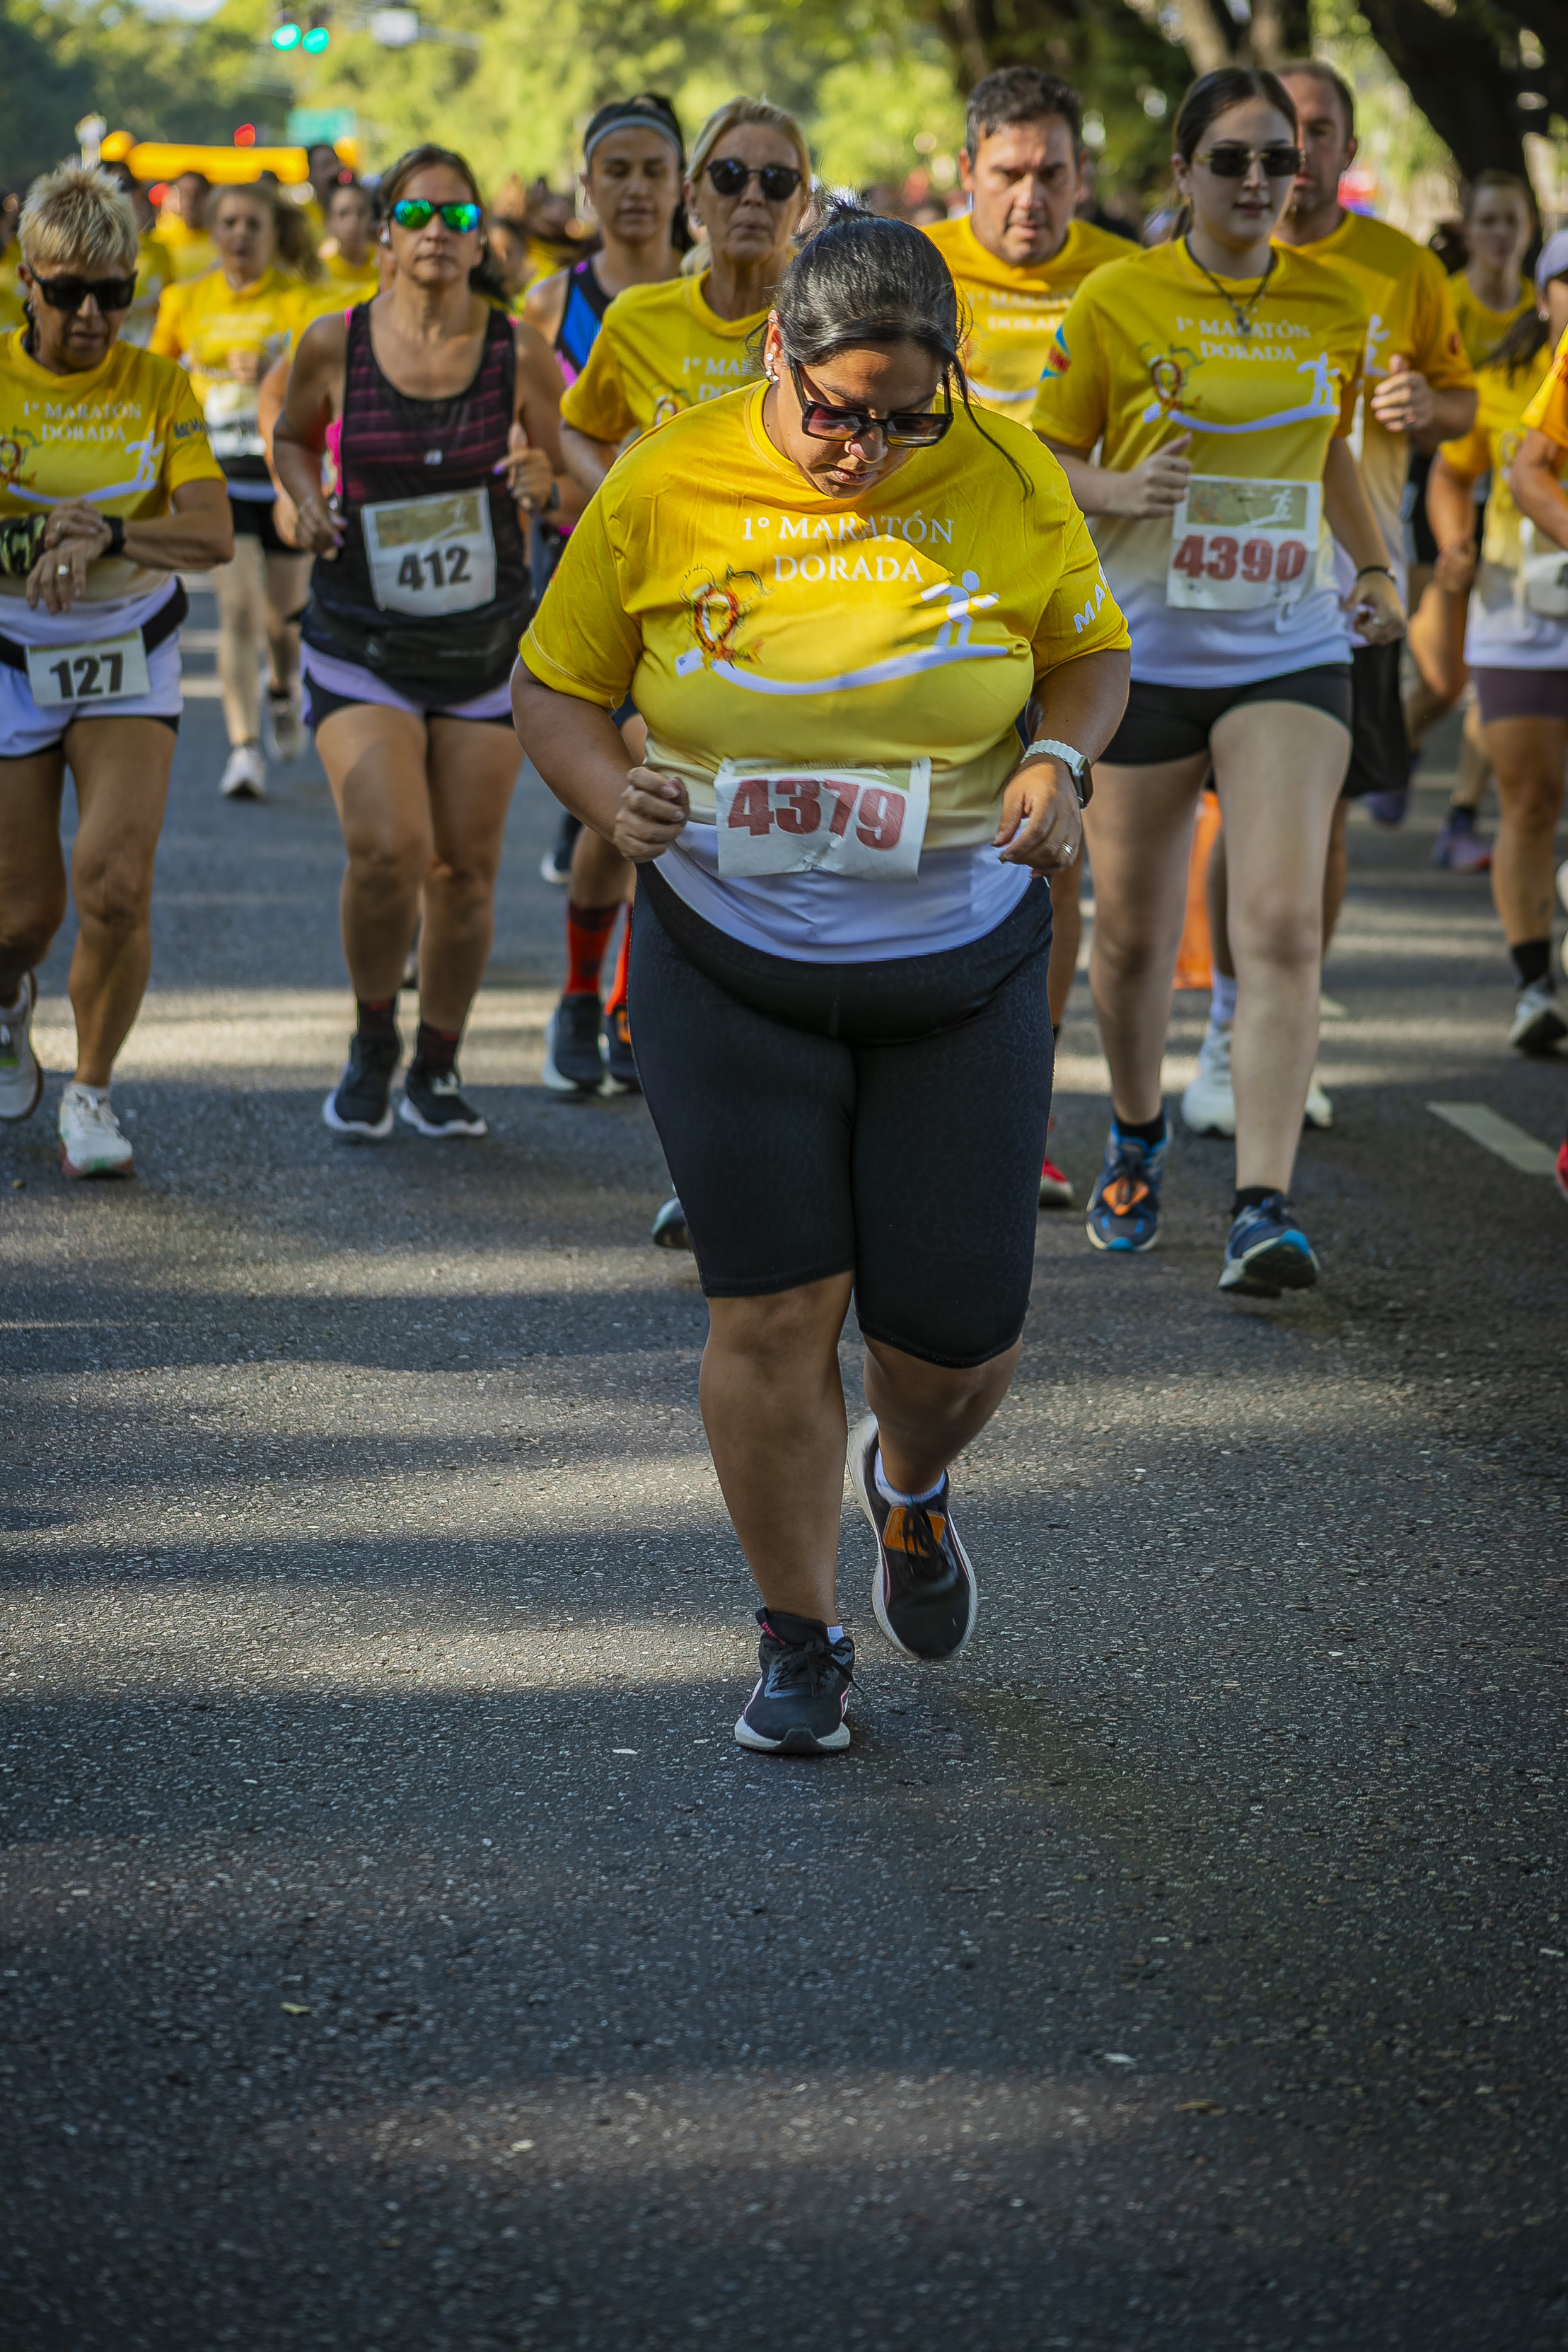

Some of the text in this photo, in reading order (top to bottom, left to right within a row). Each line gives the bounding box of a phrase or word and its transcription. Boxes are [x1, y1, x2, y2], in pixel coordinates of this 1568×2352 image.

[1200, 341, 1296, 361] DORADA
[45, 401, 141, 420] MARATÓN
[42, 423, 126, 443] DORADA
[779, 510, 954, 545] MARATÓN
[397, 545, 472, 592] 412
[773, 555, 925, 584] DORADA
[1173, 535, 1308, 584] 4390
[50, 652, 124, 700] 127
[728, 778, 907, 852] 4379
